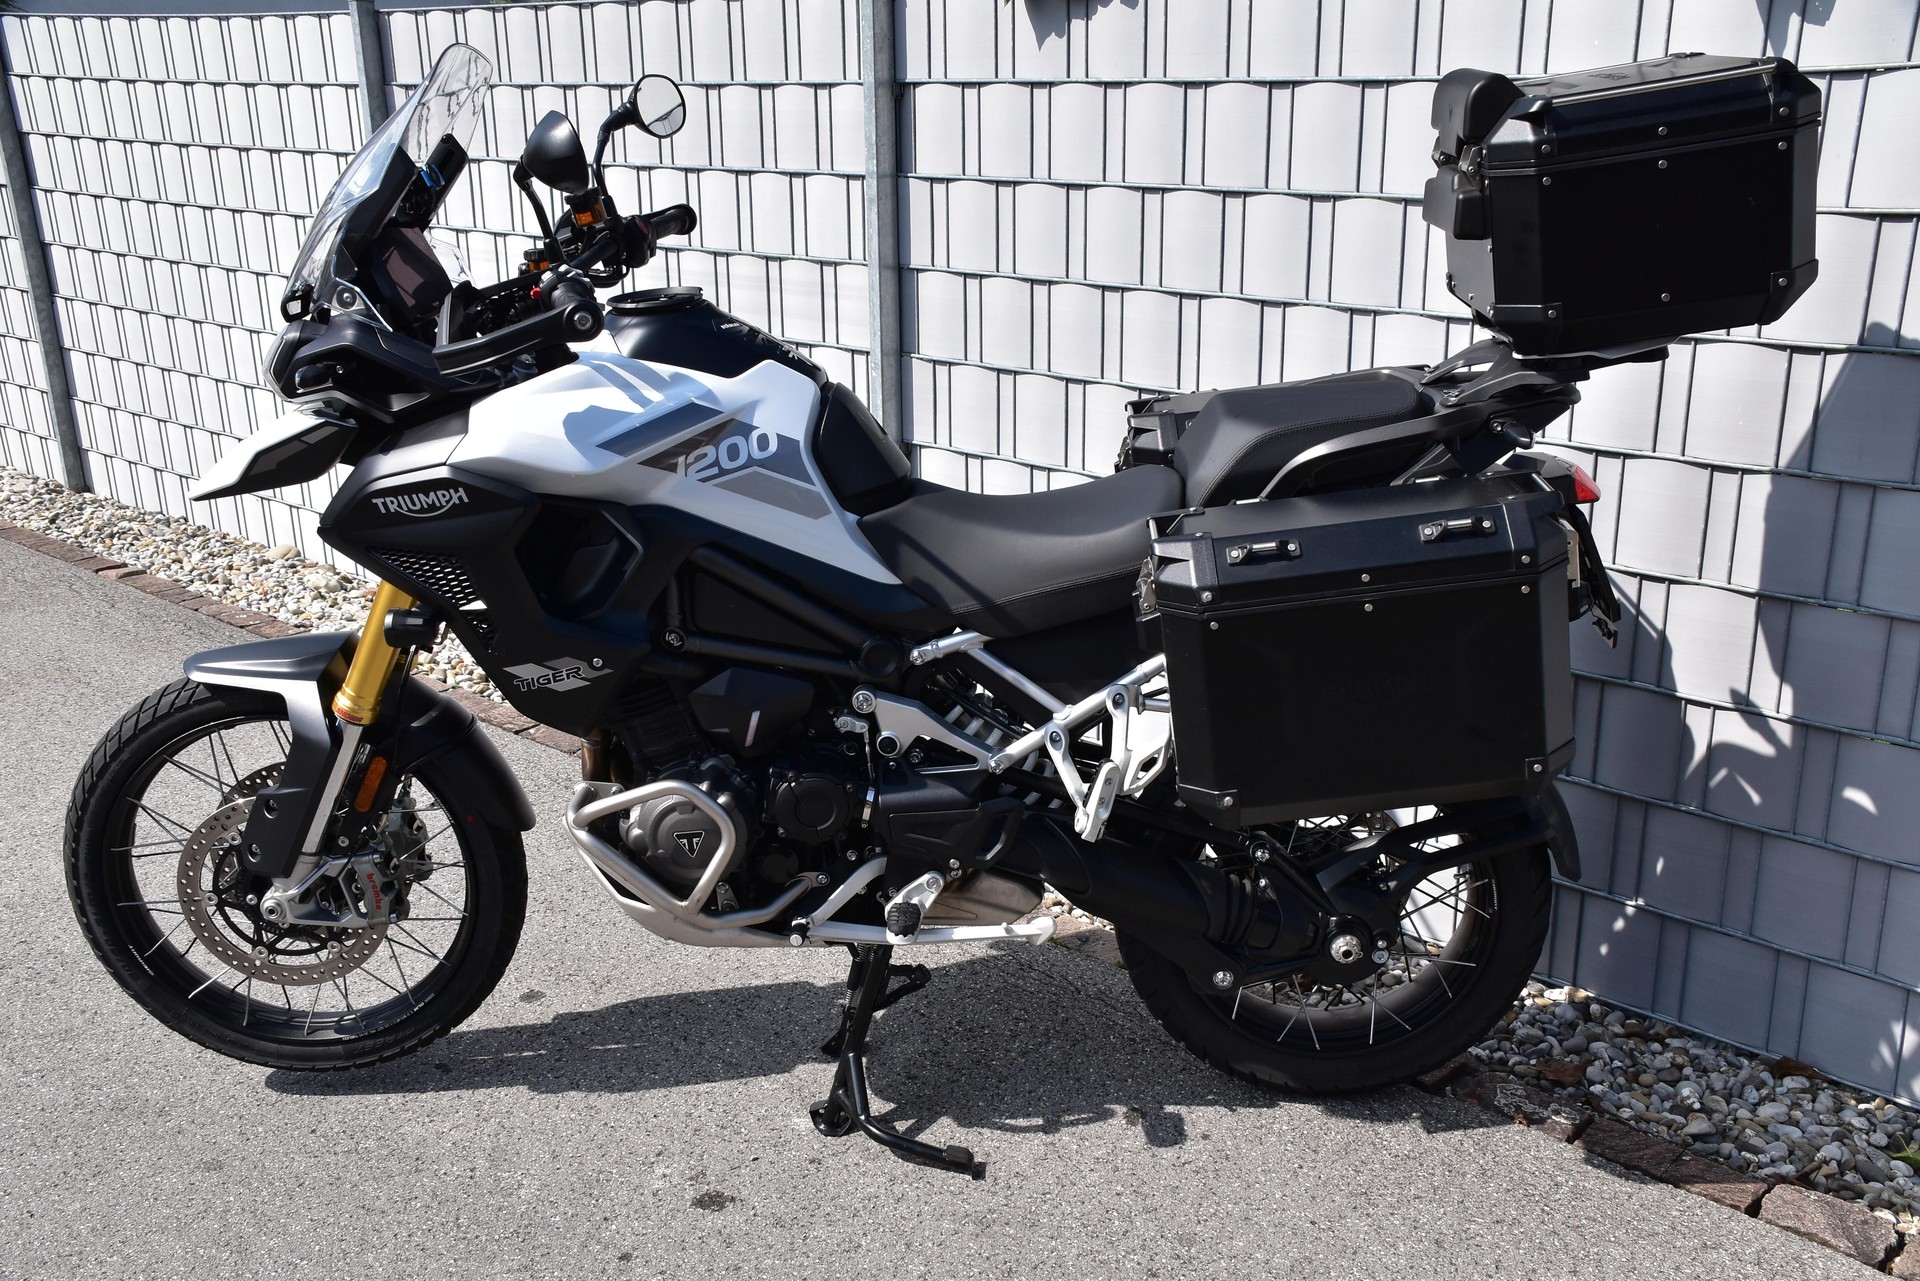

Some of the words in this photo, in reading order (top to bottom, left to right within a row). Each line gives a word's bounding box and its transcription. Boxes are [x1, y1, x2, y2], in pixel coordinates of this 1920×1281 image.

[676, 427, 778, 481] 1200
[371, 487, 469, 517] TRIUMPH
[514, 665, 585, 691] TIGER
[367, 873, 383, 910] brembo
